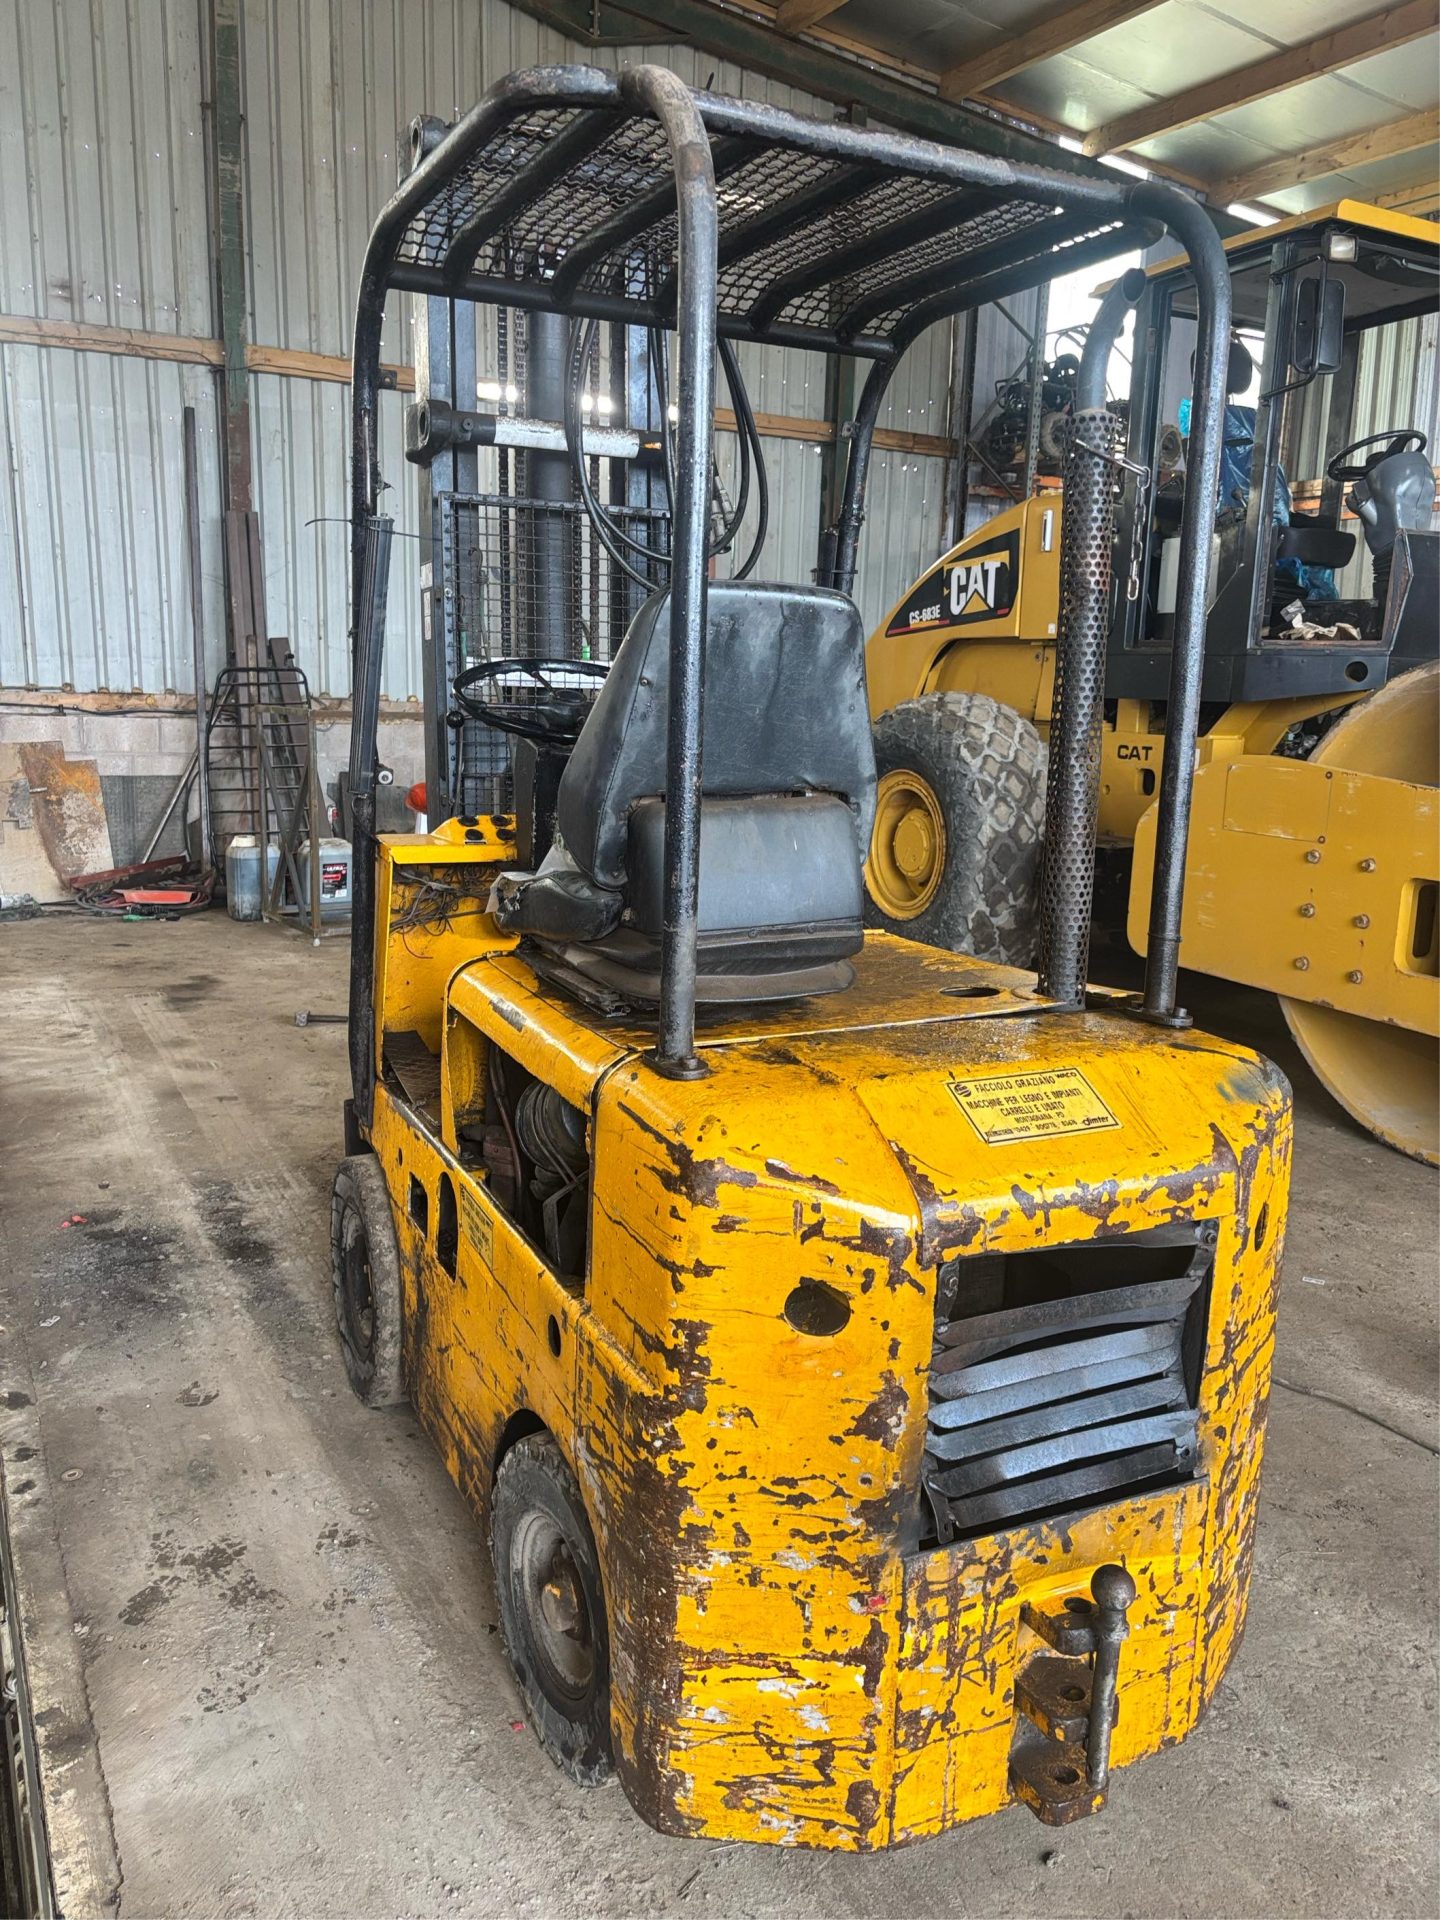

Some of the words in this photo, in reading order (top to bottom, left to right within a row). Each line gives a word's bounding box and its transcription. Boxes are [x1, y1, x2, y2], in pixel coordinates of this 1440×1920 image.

[950, 561, 1001, 616] CAT
[909, 604, 941, 625] CS-683E
[1117, 744, 1153, 761] CAT
[974, 1080, 1013, 1093] FACCIOLO
[1014, 1075, 1056, 1088] GRAZIANO
[966, 1098, 1004, 1109] MACCHINE
[1004, 1095, 1020, 1105] PER
[1019, 1092, 1044, 1103] LEGNO
[1043, 1091, 1051, 1100] E
[1051, 1088, 1083, 1099] IMPIANTI
[1000, 1105, 1035, 1117] CARRELLI
[1033, 1104, 1041, 1112] E
[1041, 1101, 1065, 1111] USATO
